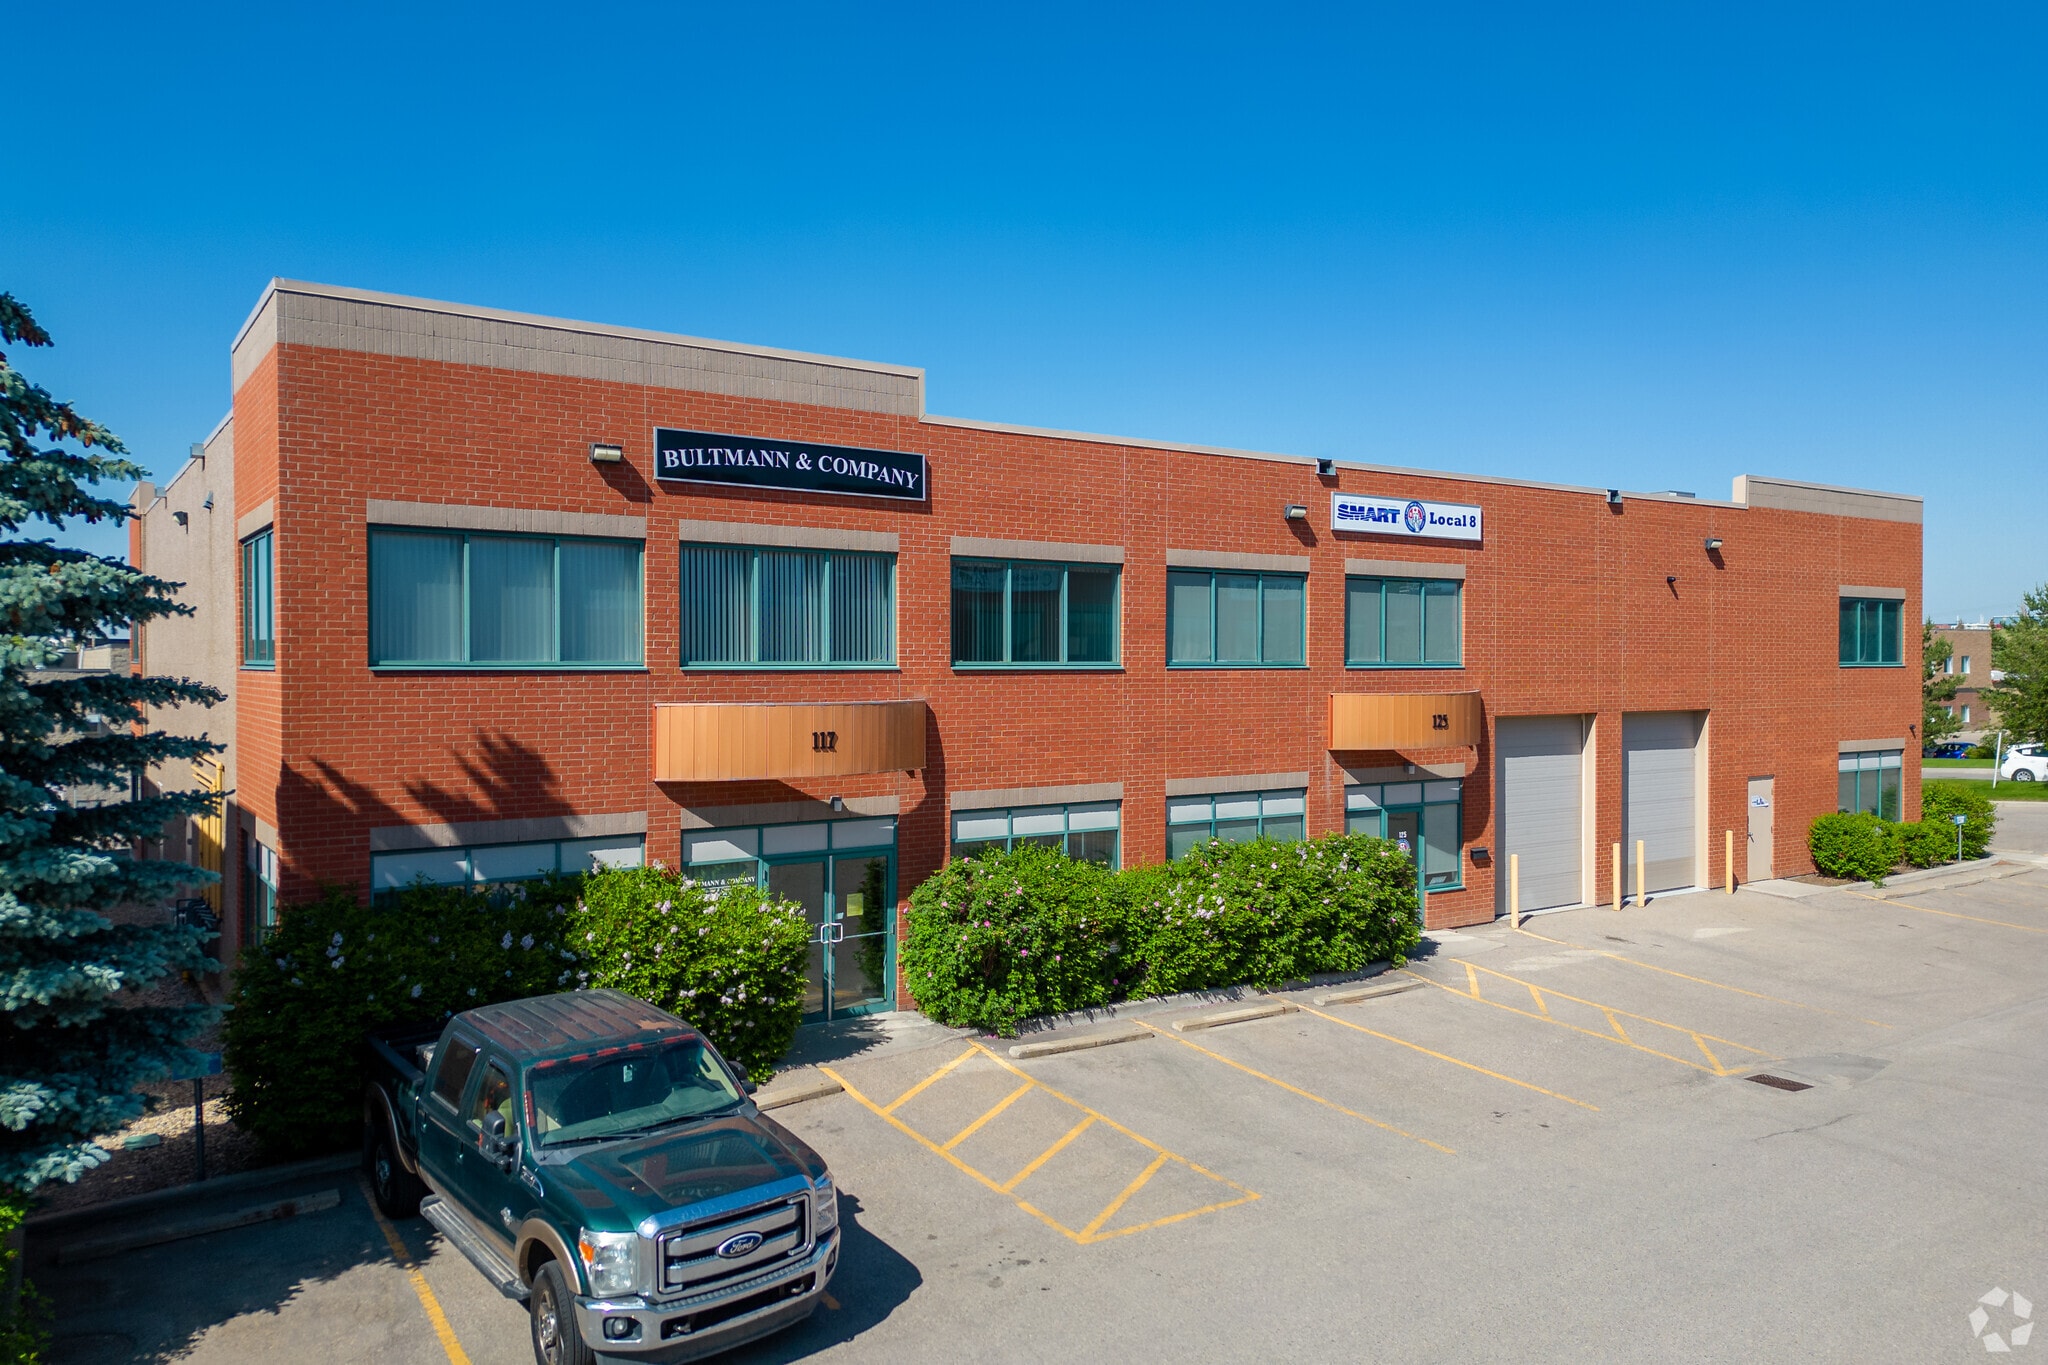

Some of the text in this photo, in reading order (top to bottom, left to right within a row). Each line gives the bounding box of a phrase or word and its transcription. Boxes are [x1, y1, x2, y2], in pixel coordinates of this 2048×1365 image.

[662, 447, 920, 490] BULTMANN & COMPANY
[1337, 503, 1400, 524] SMART
[1429, 511, 1467, 528] Local
[1469, 515, 1477, 528] 8
[1432, 713, 1449, 730] 125
[812, 731, 838, 752] 117
[730, 1238, 754, 1254] Ford
